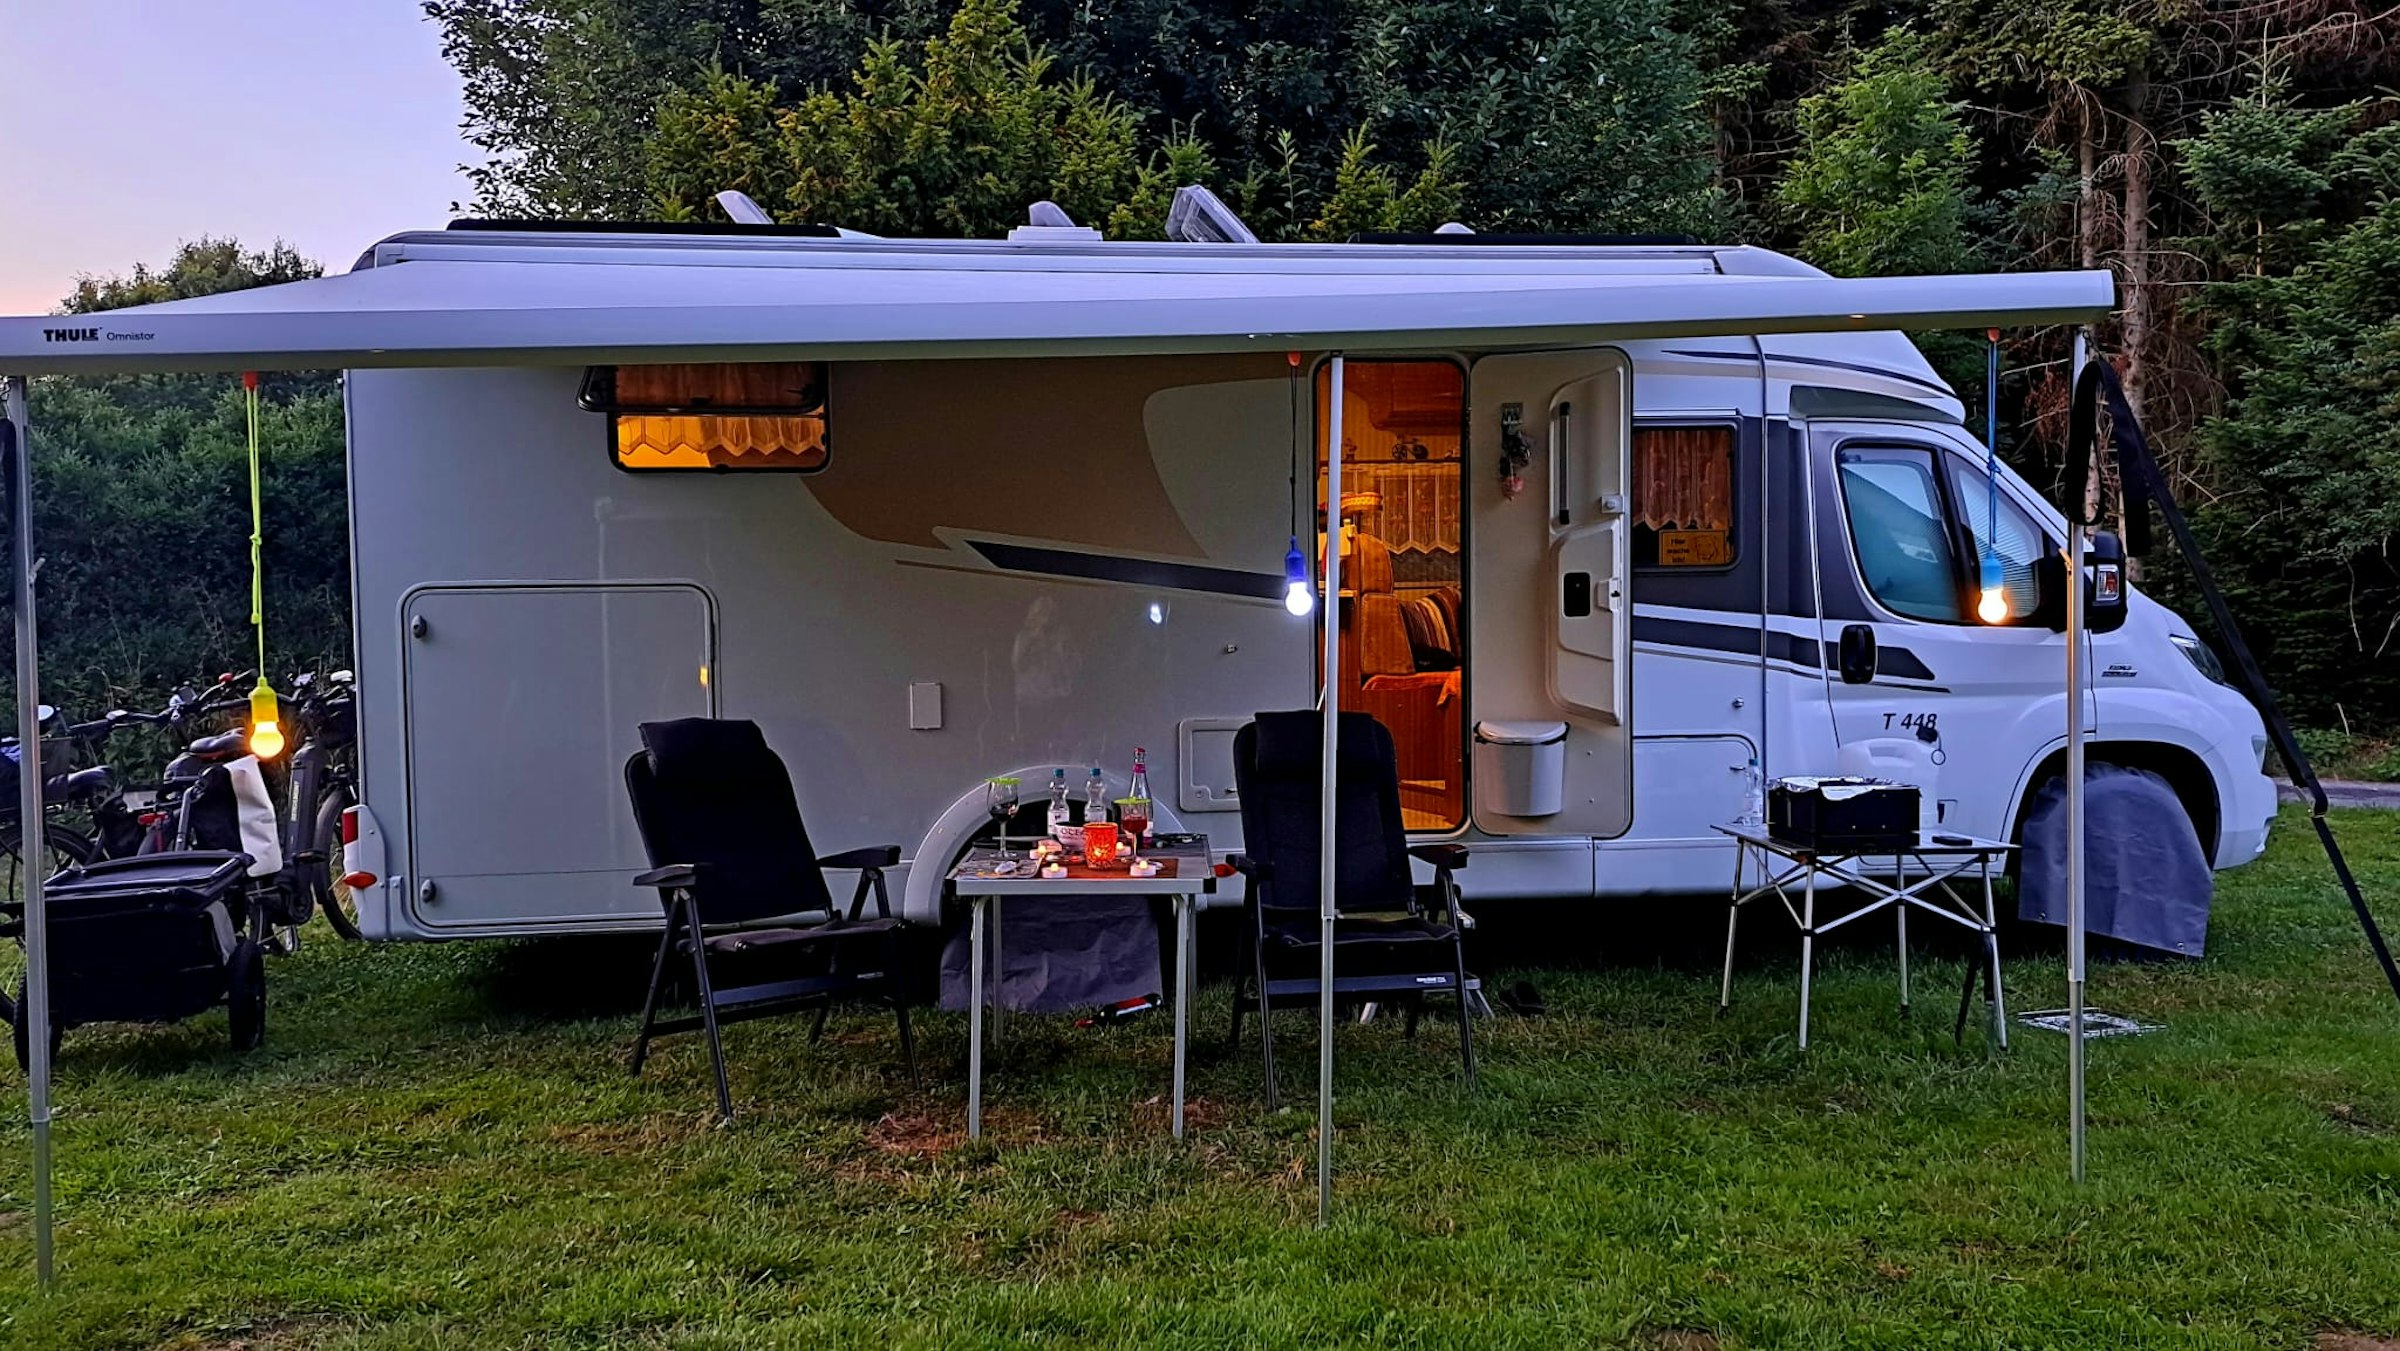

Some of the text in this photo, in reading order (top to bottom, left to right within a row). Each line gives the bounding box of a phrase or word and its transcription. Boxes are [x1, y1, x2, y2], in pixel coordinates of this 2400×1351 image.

[43, 327, 99, 342] THULE
[1883, 713, 1938, 730] T 448
